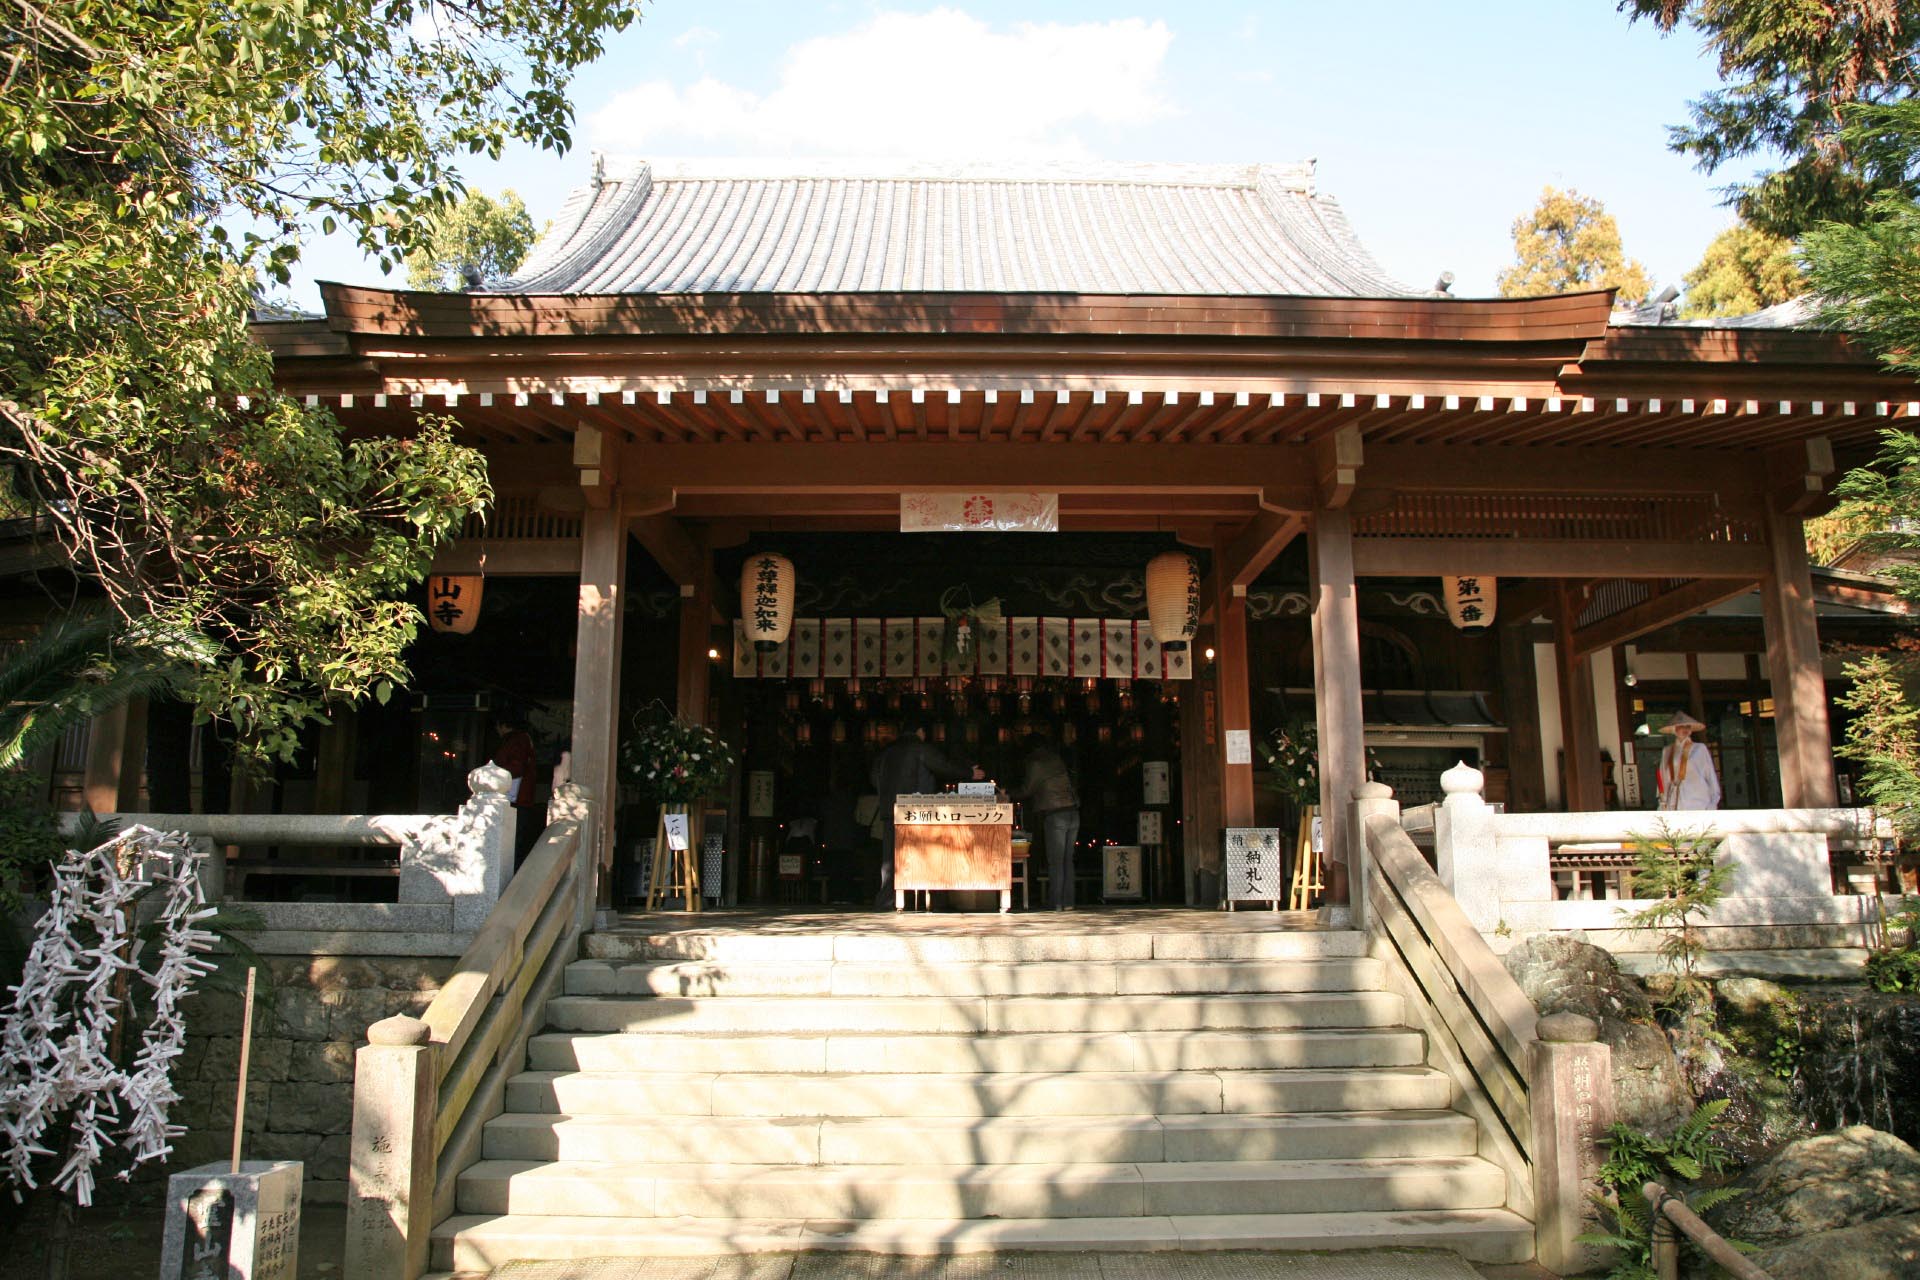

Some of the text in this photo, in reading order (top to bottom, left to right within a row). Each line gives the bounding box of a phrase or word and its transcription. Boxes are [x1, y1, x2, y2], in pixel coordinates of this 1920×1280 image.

[904, 810, 1004, 822] お願いローソク
[1246, 850, 1263, 894] 納札入
